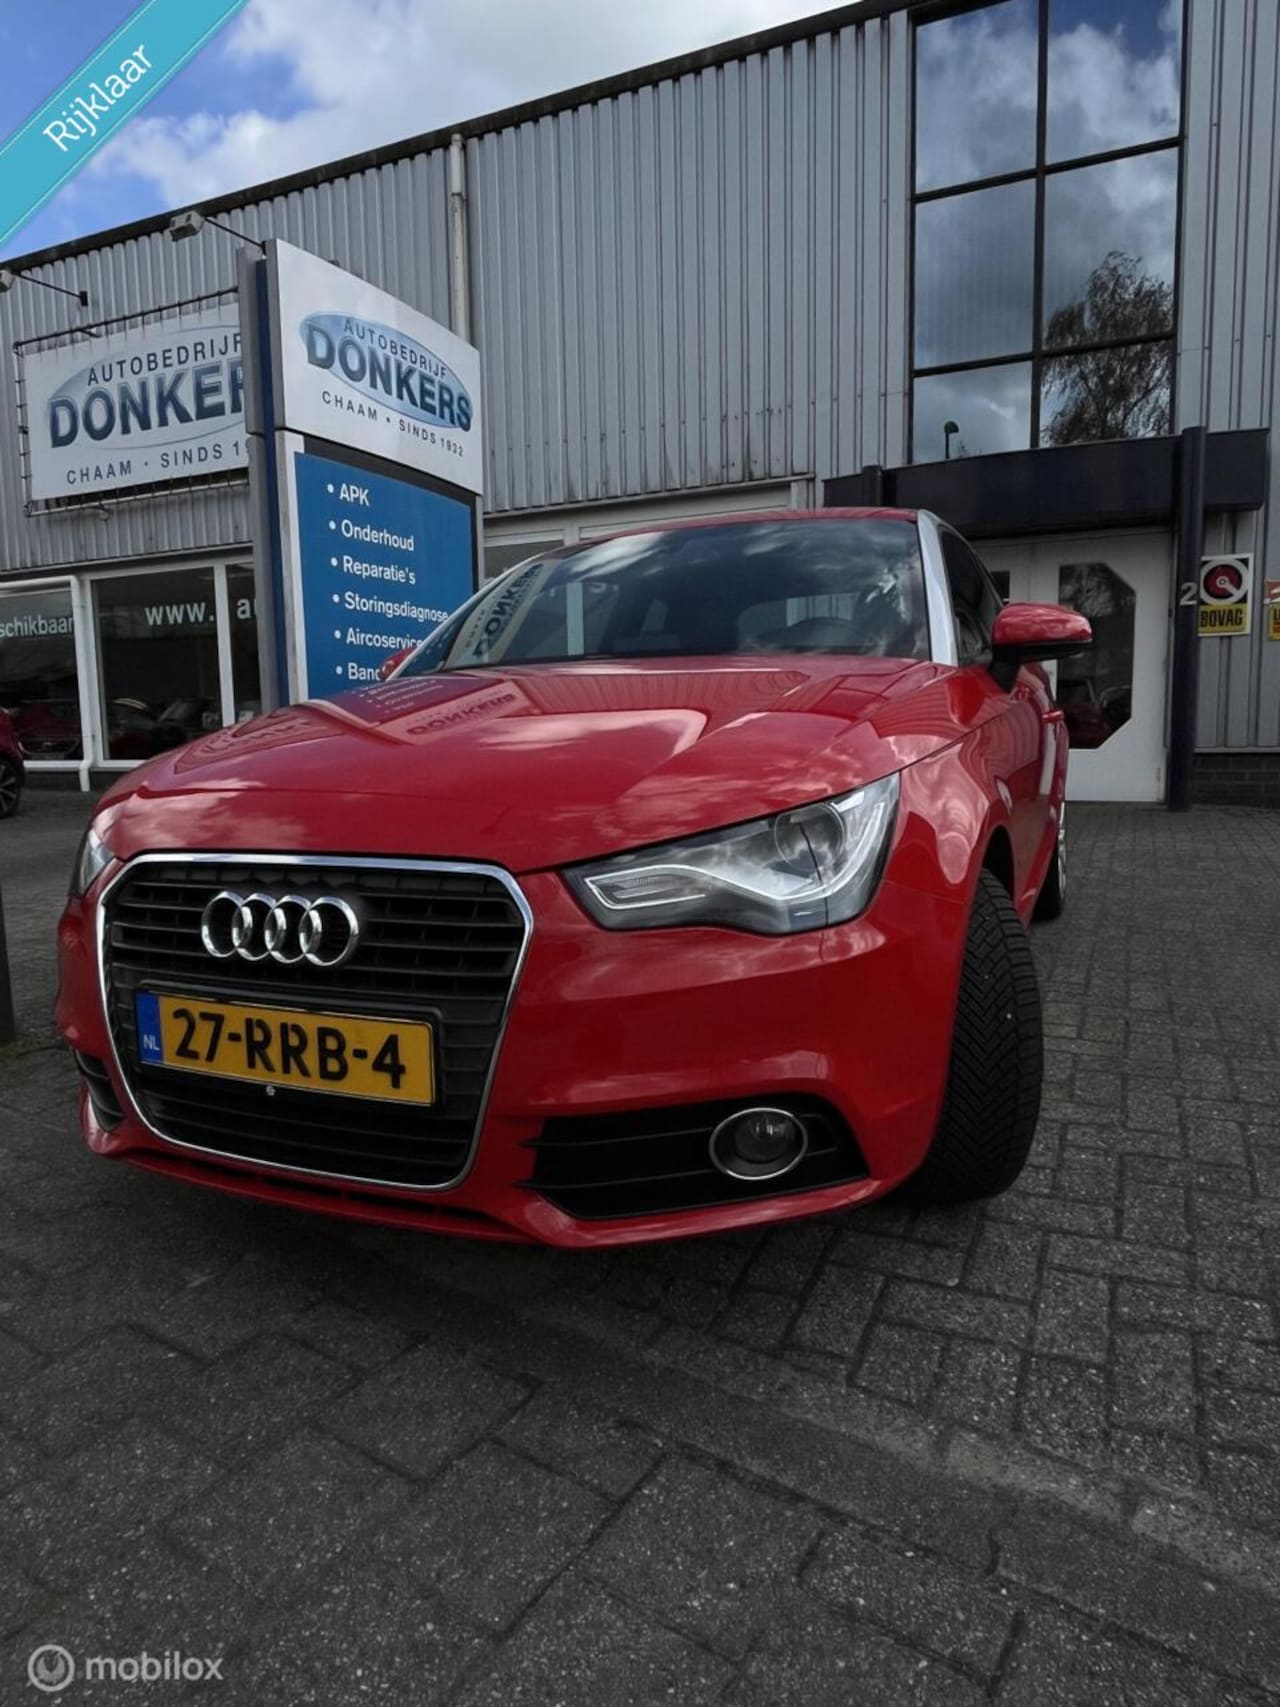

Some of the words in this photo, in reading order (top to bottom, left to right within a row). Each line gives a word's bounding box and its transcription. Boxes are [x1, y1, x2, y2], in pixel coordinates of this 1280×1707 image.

[343, 317, 447, 379] AUTOBEDRIJF
[306, 322, 472, 432] DONKERS
[321, 390, 379, 422] CHAAM
[398, 418, 436, 445] SINDS
[66, 460, 132, 485] CHAAM
[160, 443, 223, 469] SINDS
[339, 482, 370, 507] APK
[341, 519, 415, 552] Onderhoud
[342, 555, 416, 585] Reparatie's
[344, 591, 449, 623] Storingsdiagnose
[1180, 582, 1198, 606] 2
[1200, 608, 1243, 628] BOVAG
[143, 1034, 160, 1051] NL
[172, 1008, 406, 1089] 27-RRB-4
